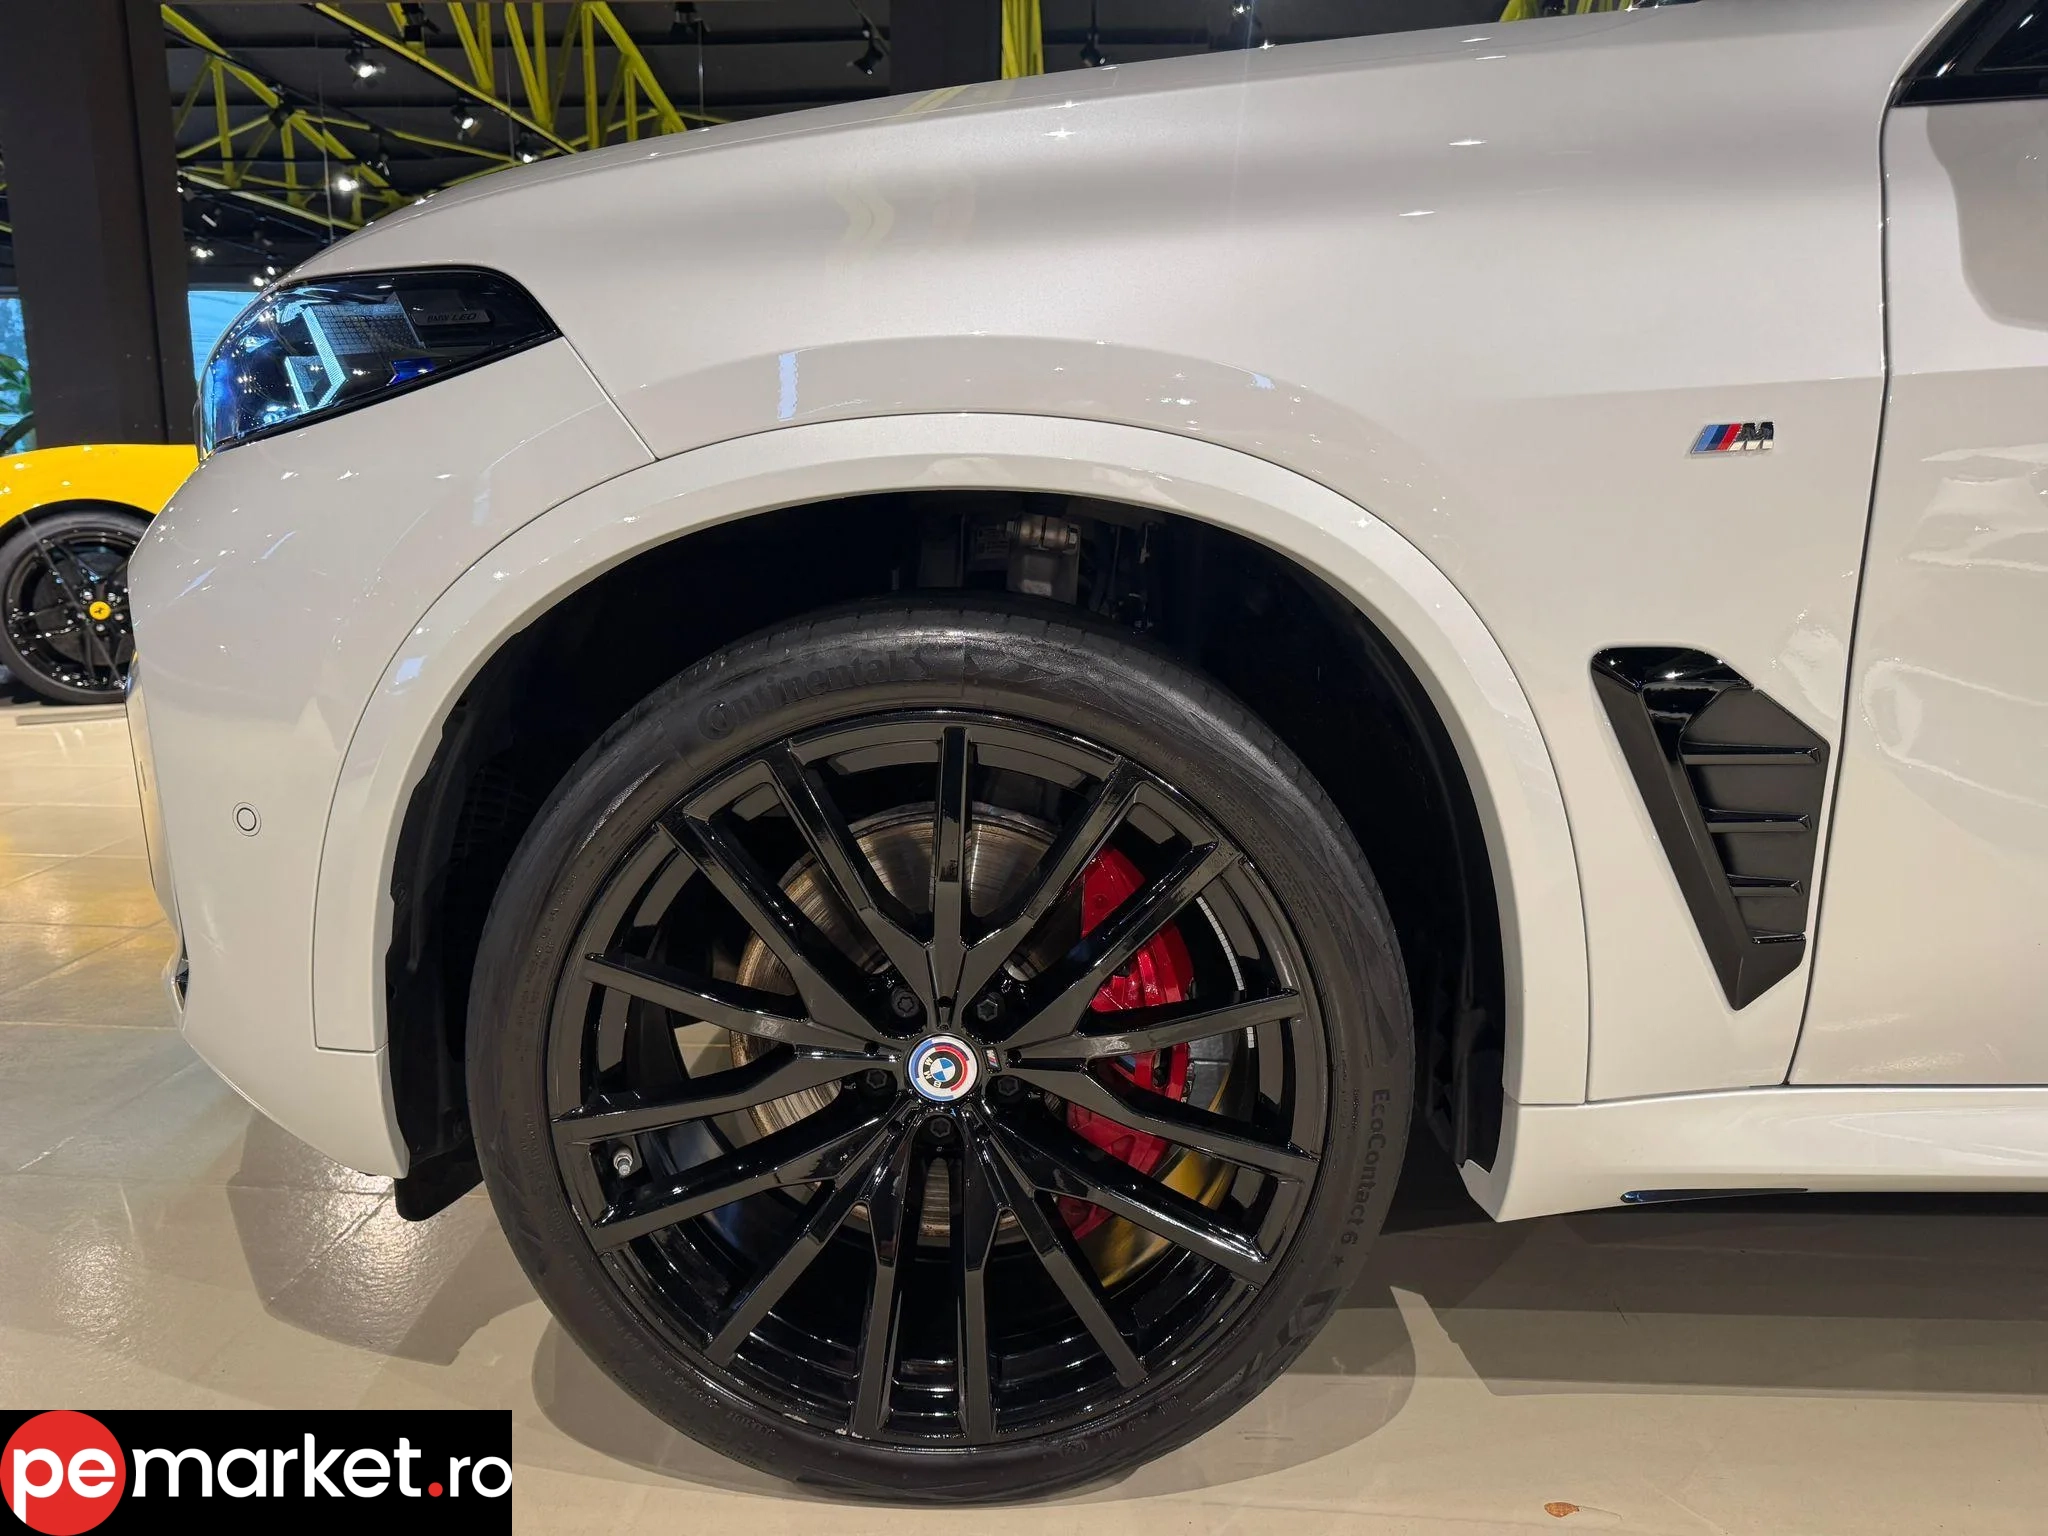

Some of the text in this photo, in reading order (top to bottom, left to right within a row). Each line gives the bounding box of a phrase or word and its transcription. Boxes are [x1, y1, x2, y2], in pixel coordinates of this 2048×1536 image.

[451, 313, 478, 321] LED
[923, 1057, 942, 1088] BMW
[1348, 1089, 1391, 1227] EcoContact
[1340, 1231, 1358, 1245] 6
